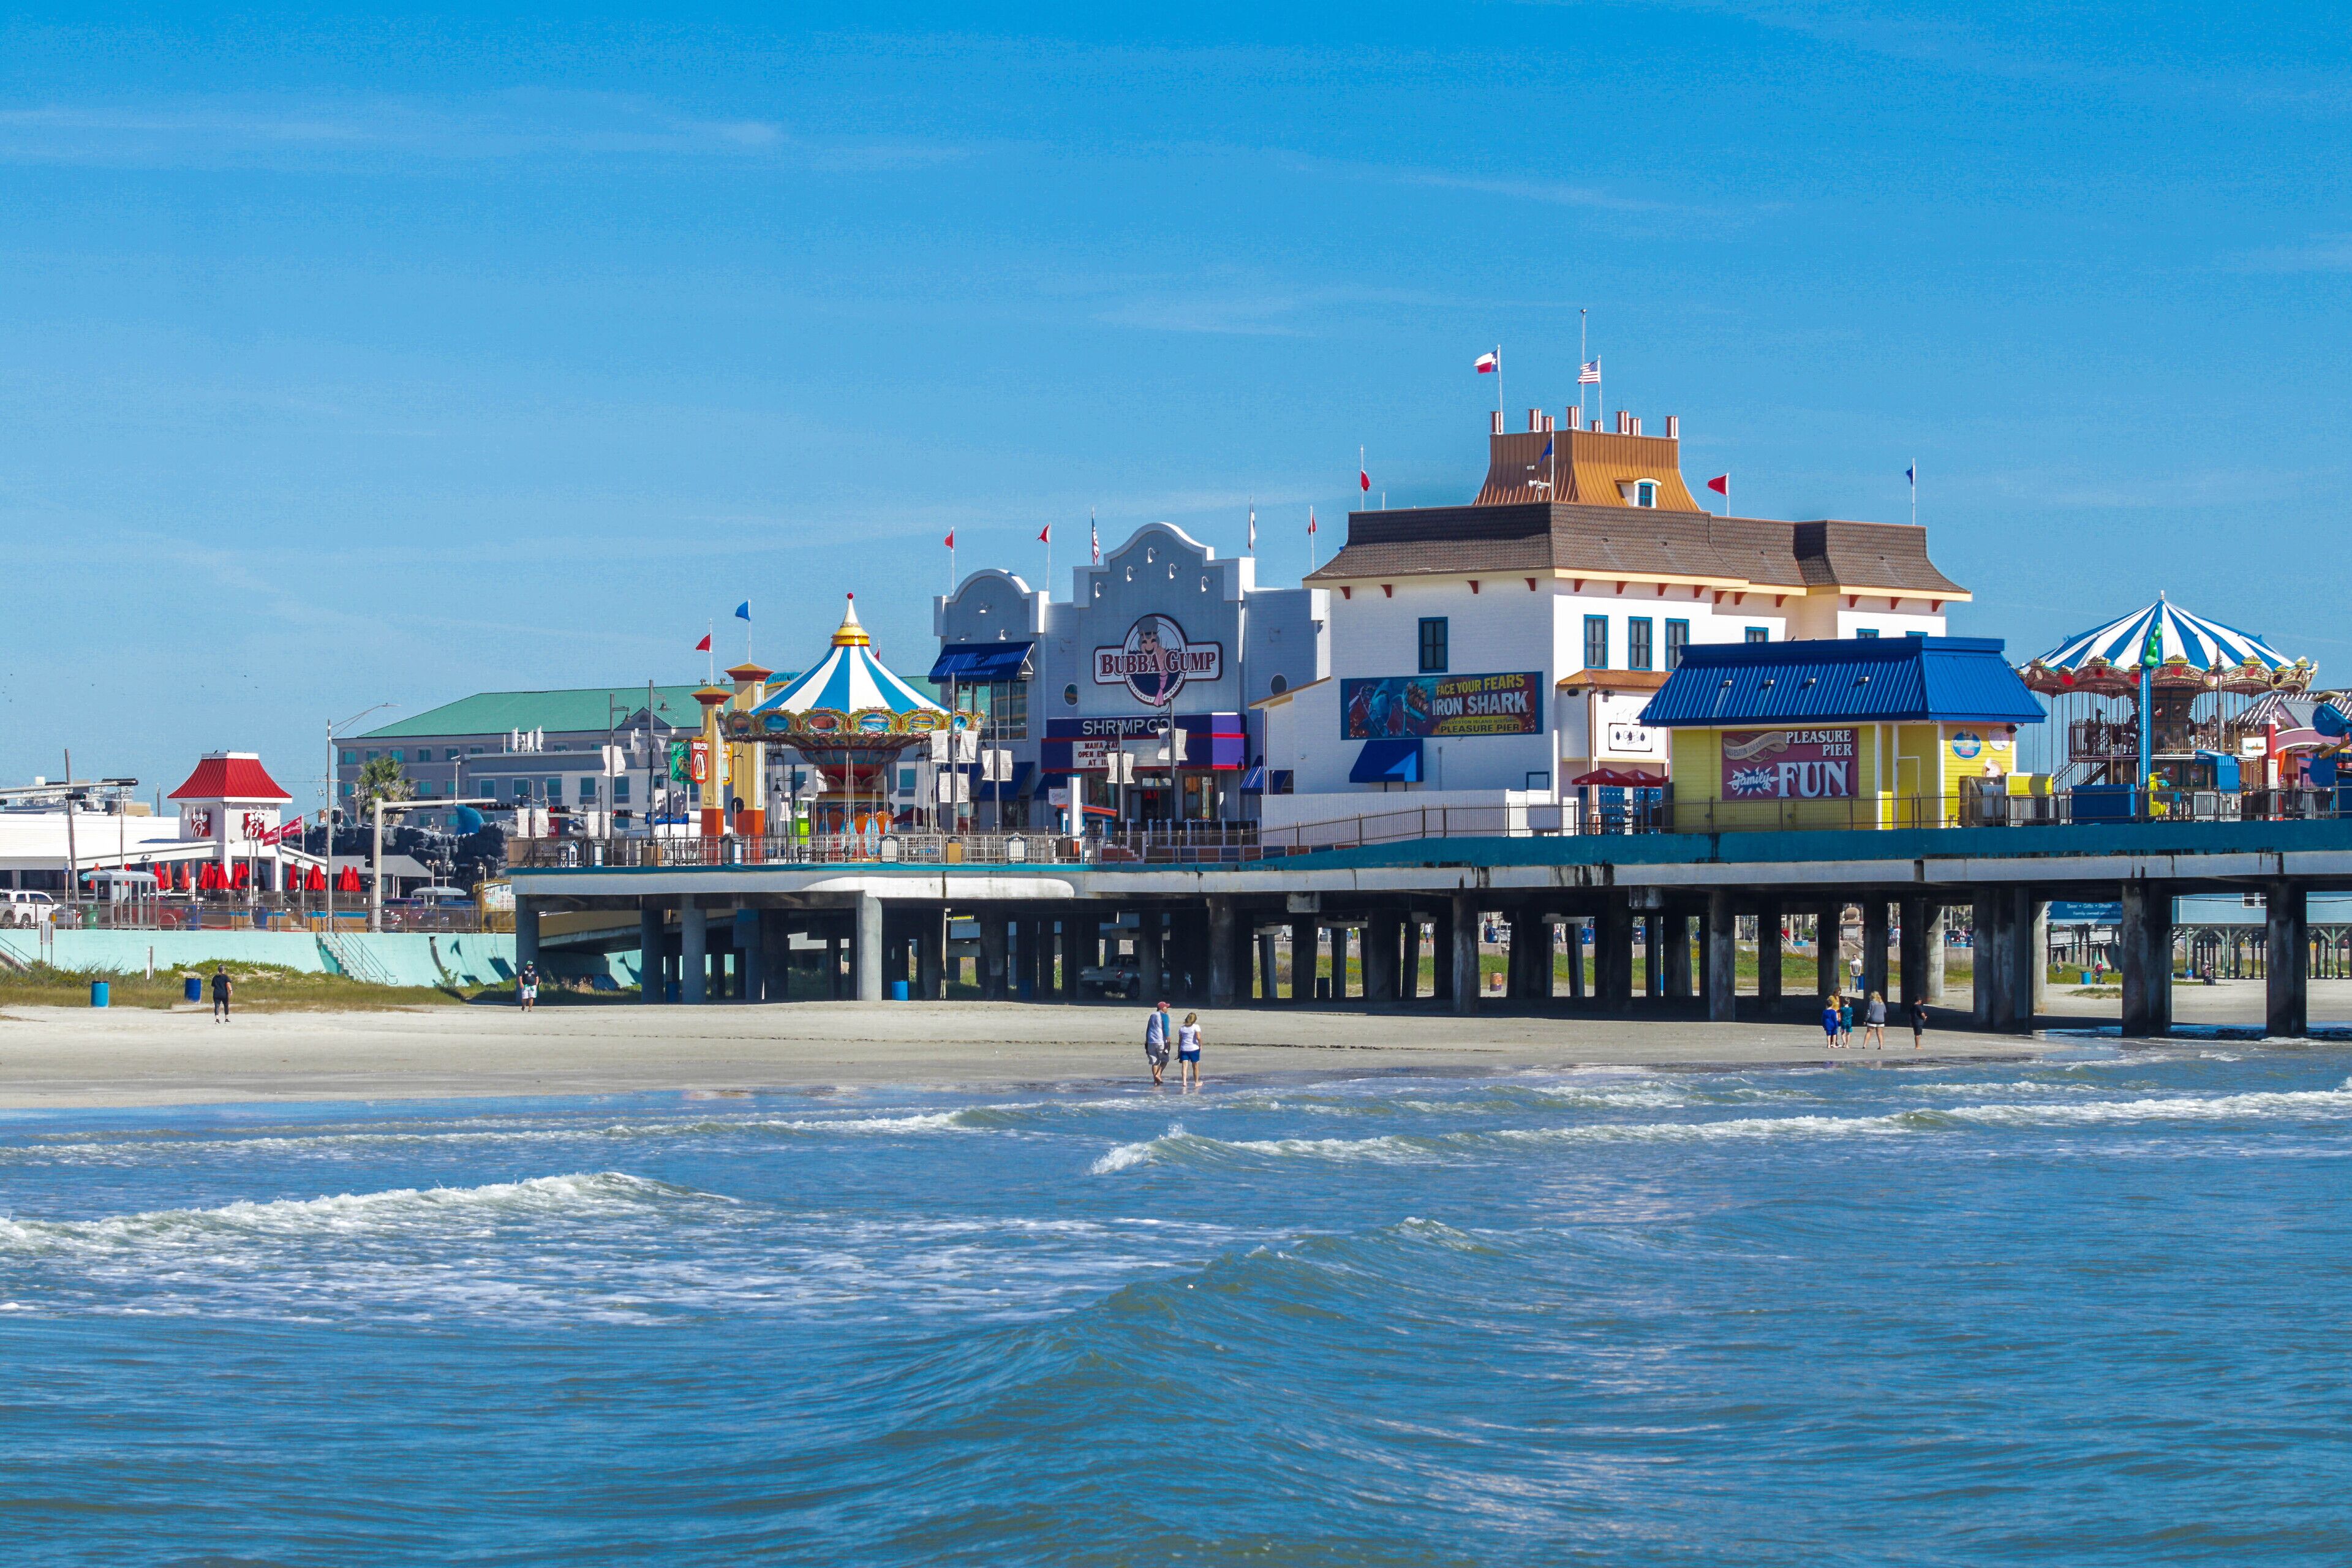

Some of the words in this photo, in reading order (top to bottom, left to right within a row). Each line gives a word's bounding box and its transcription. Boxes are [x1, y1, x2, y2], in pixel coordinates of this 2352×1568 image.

[1100, 654, 1161, 676] BUBBA
[1164, 650, 1216, 673] GUMP
[1127, 677, 1152, 701] RESTAURANT
[1436, 683, 1455, 696] FACE
[1456, 679, 1482, 693] YOUR
[1484, 674, 1525, 691] FEARS
[1432, 697, 1463, 715] IRON
[1467, 690, 1529, 715] SHARK
[1441, 724, 1493, 733] PLEASURE
[1496, 723, 1520, 732] PIER
[1785, 729, 1852, 744] PLEASURE
[1822, 744, 1853, 756] PIER
[1732, 772, 1772, 790] Family
[1777, 761, 1850, 798] FUN
